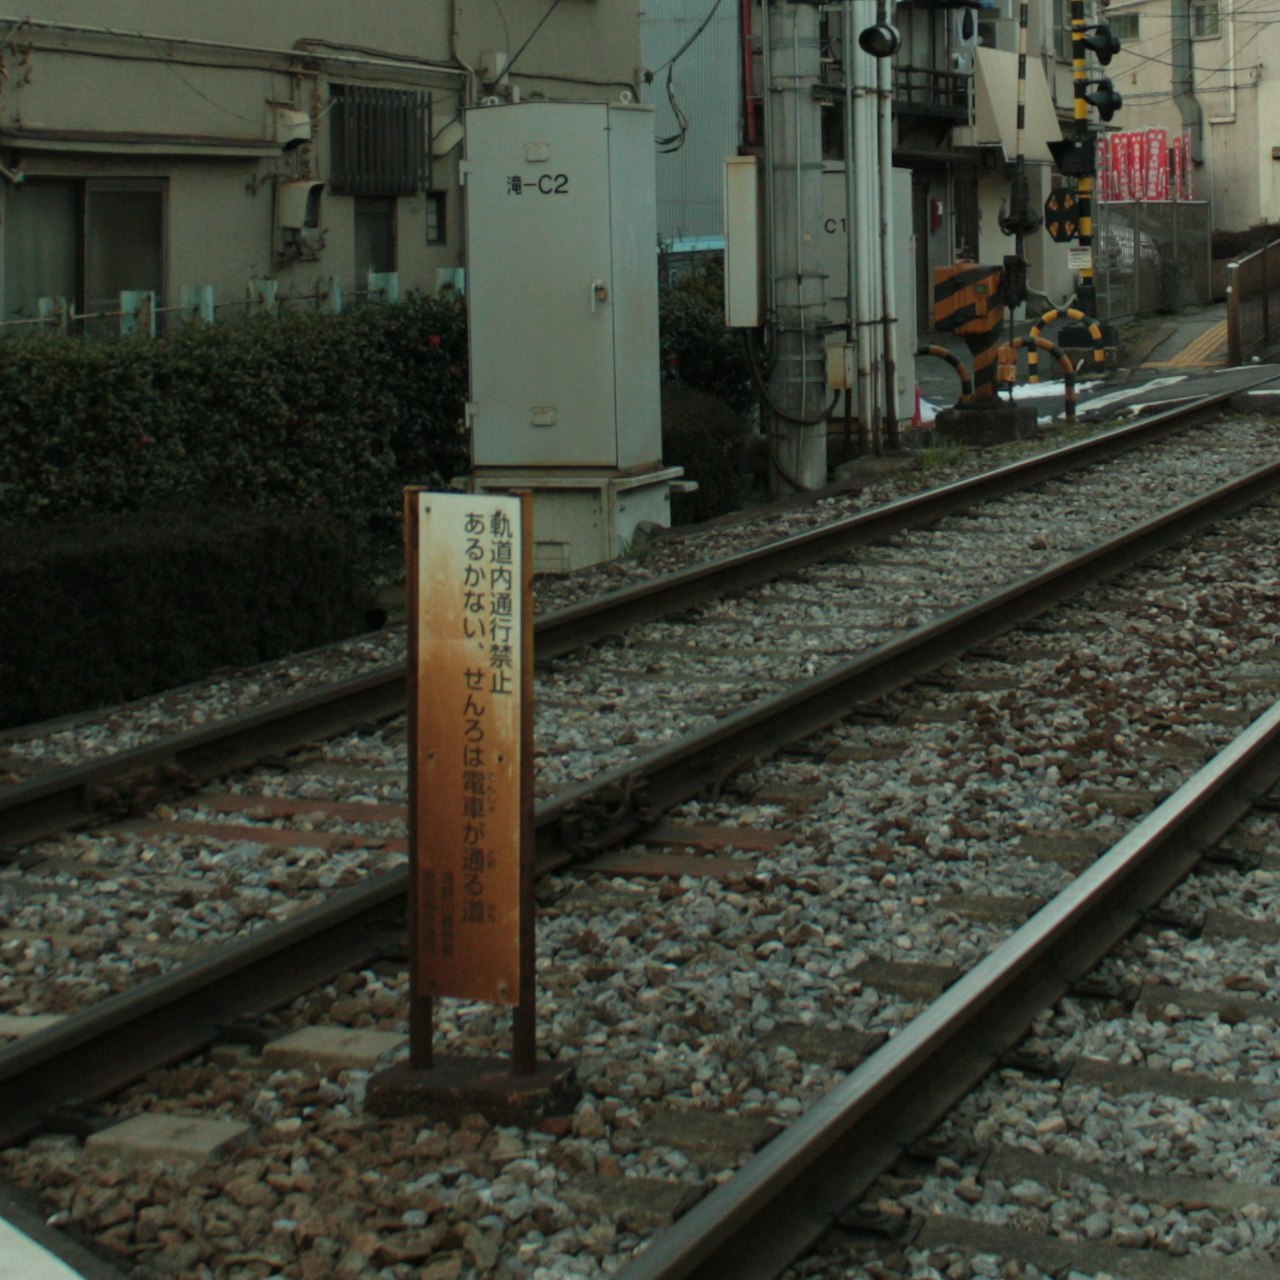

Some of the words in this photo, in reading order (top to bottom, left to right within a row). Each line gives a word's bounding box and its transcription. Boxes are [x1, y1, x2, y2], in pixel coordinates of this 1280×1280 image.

[824, 218, 846, 234] C1
[489, 511, 512, 695] 軌道内通行禁止
